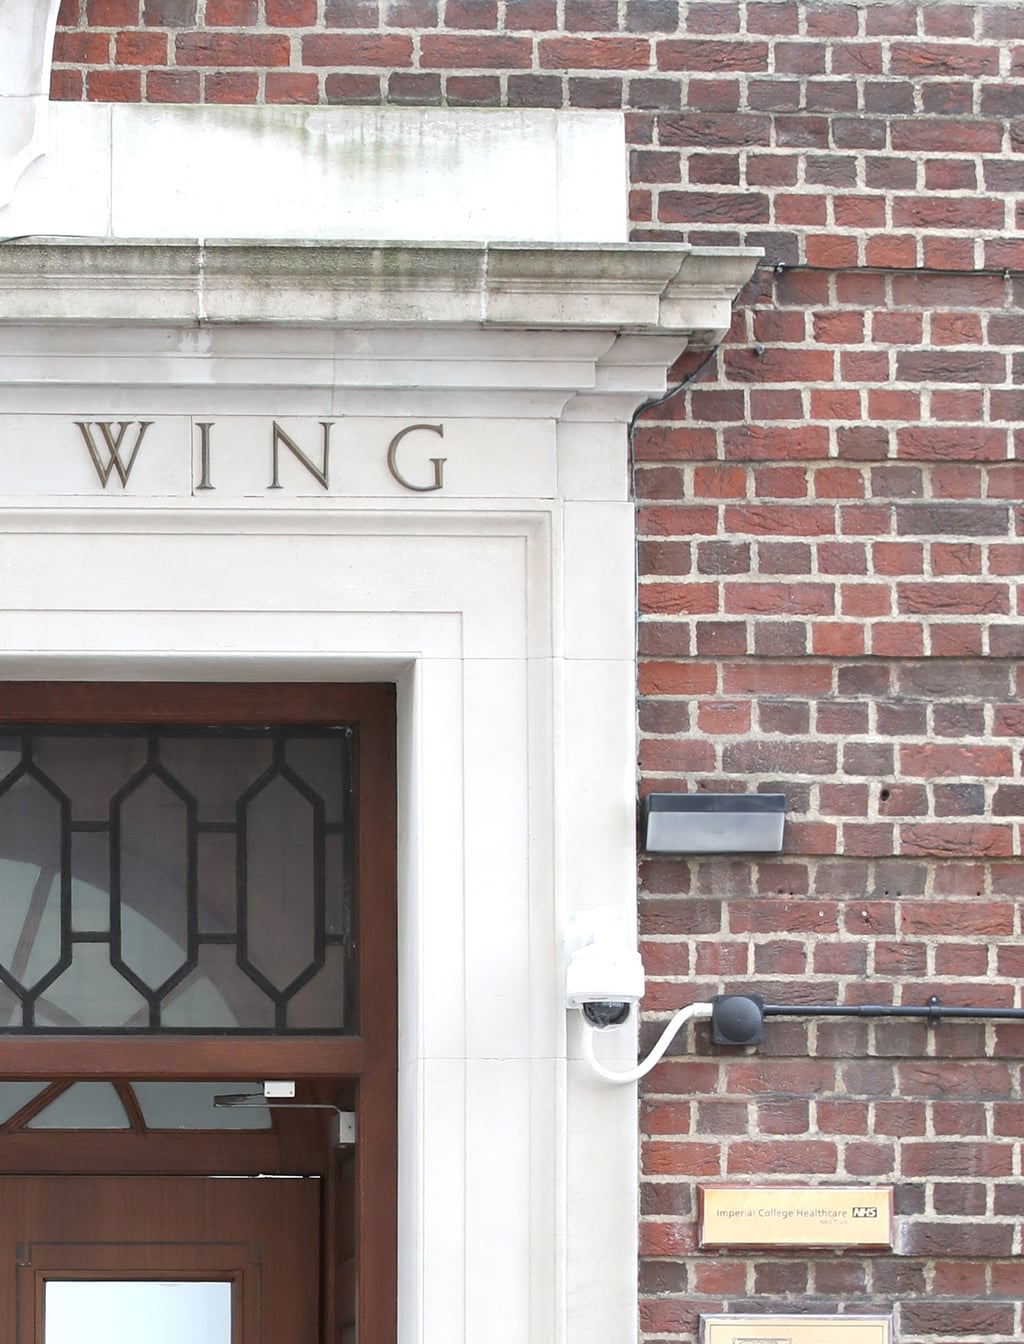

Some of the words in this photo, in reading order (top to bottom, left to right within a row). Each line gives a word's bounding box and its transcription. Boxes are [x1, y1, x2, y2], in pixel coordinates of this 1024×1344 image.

[75, 420, 449, 492] WING
[716, 1208, 755, 1218] Imperial
[758, 1208, 794, 1219] College
[796, 1208, 848, 1218] Healthcare
[852, 1207, 877, 1218] NHS
